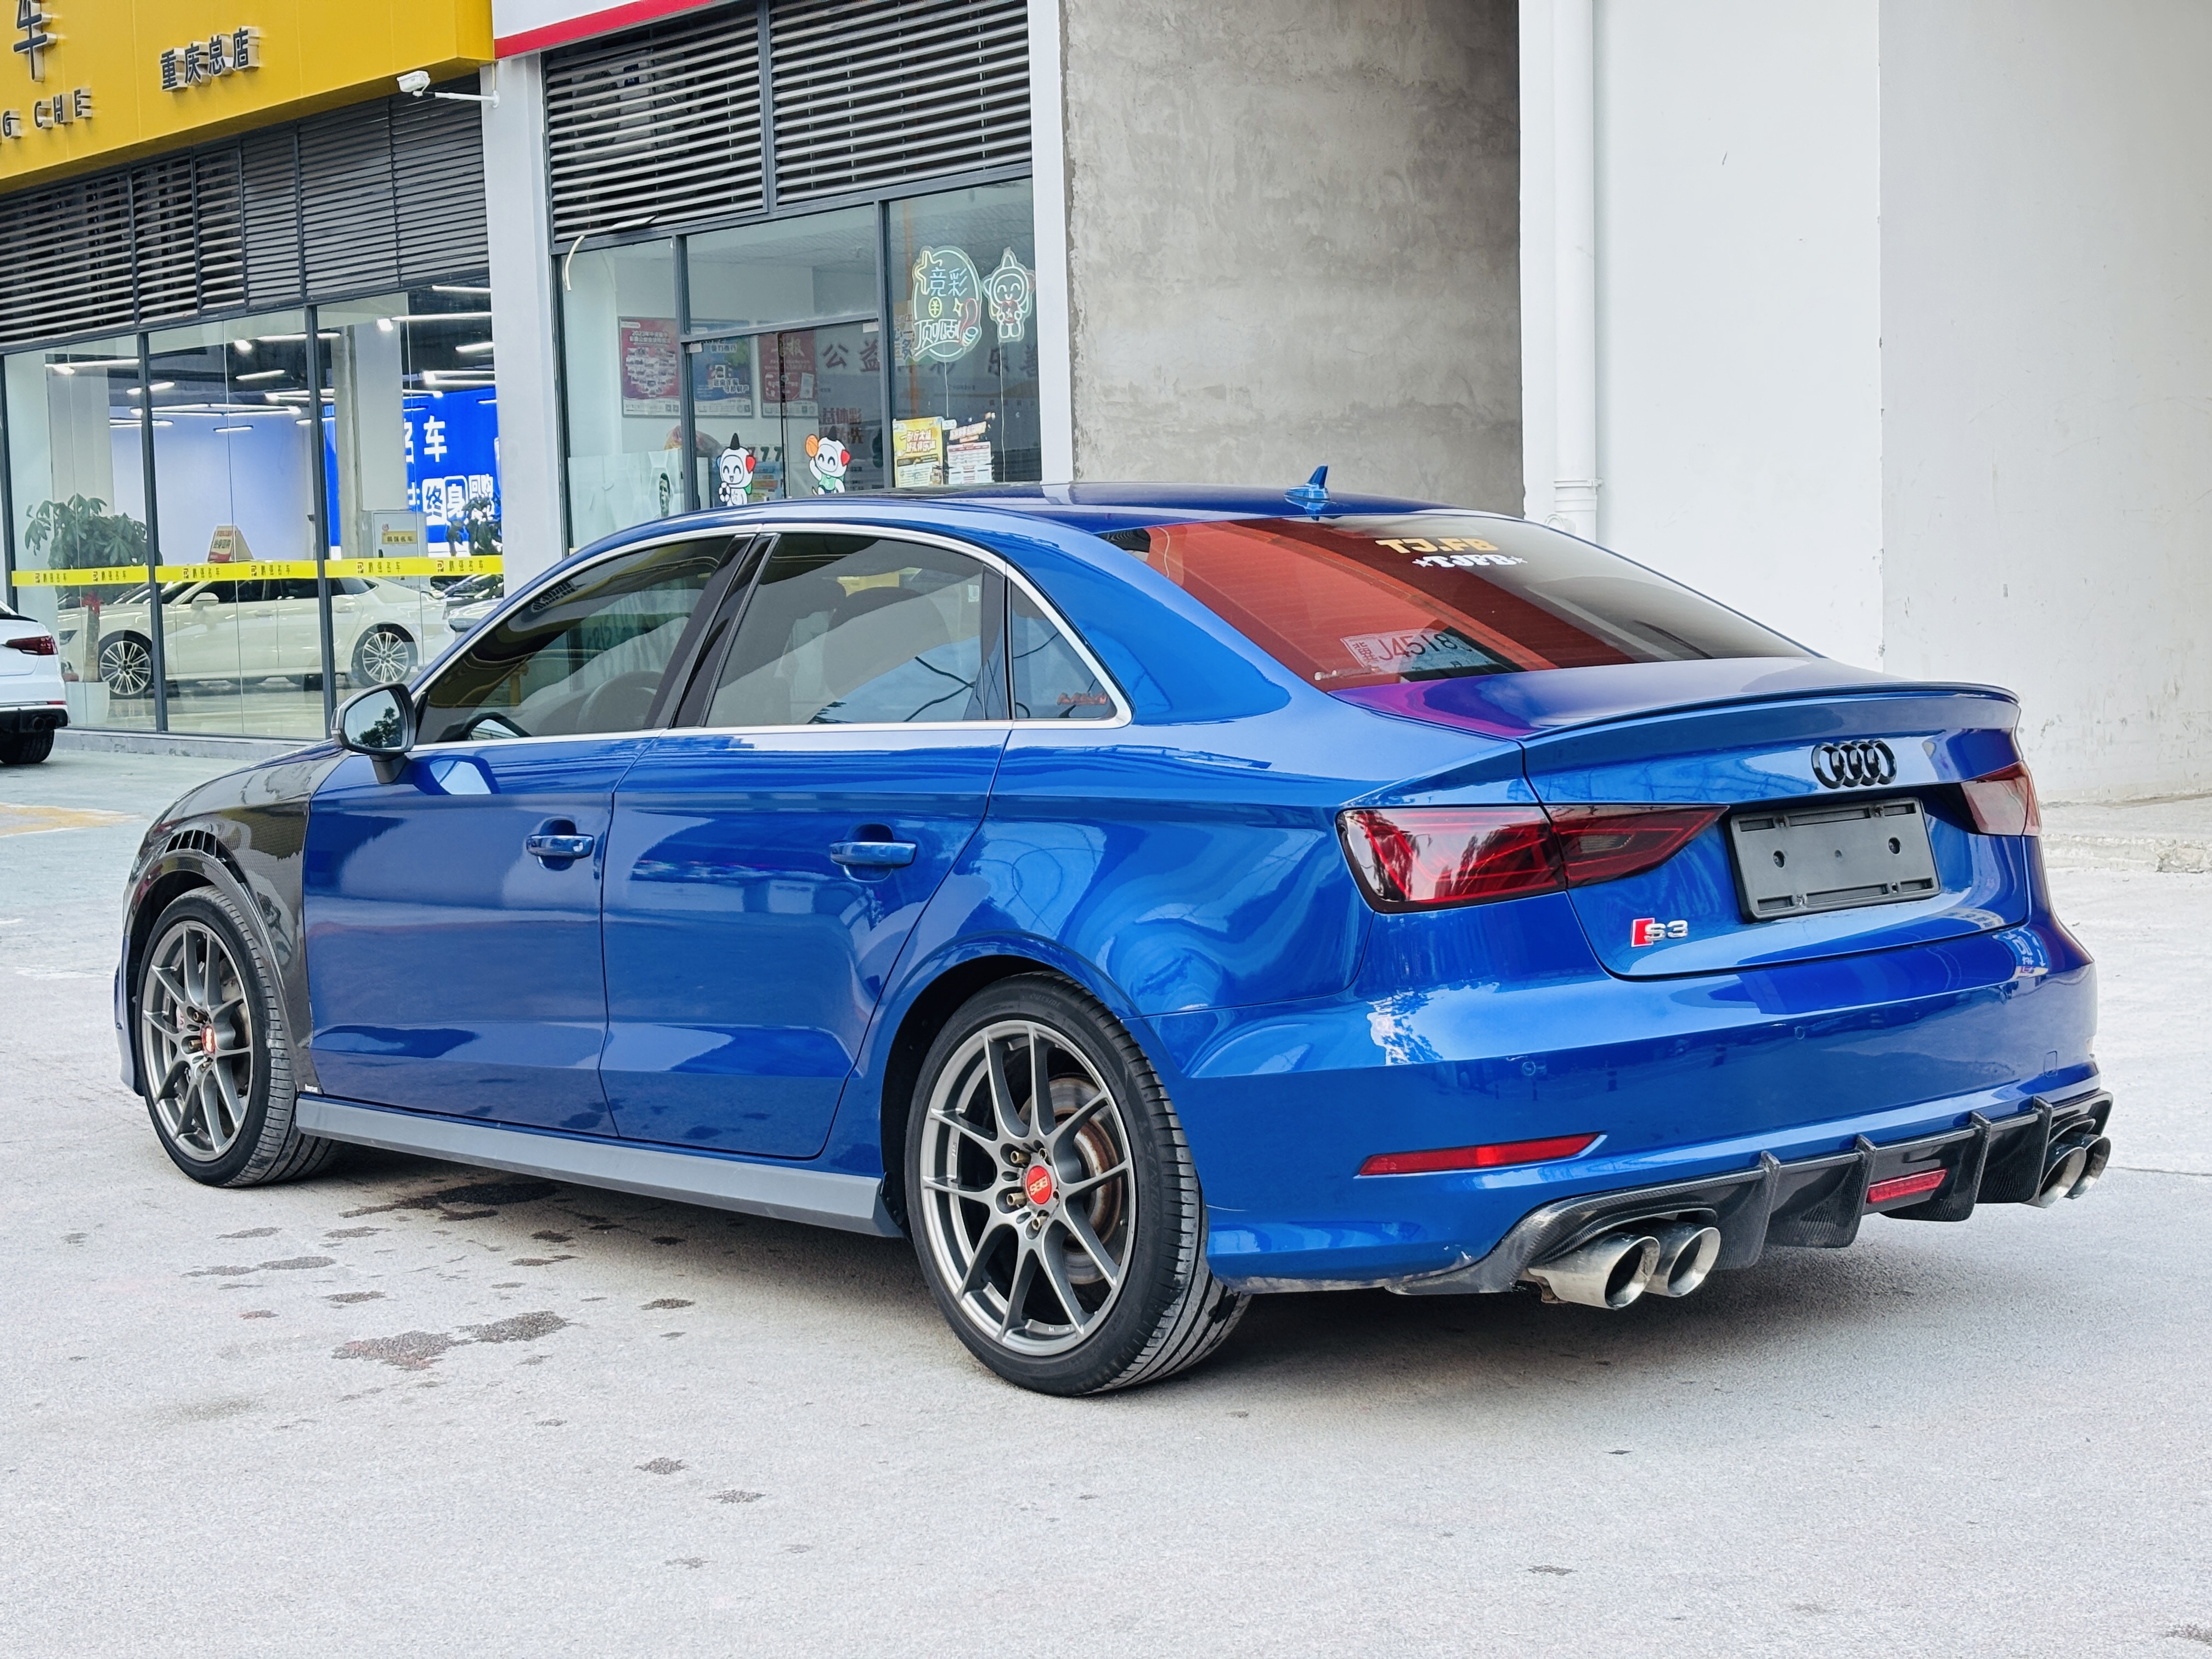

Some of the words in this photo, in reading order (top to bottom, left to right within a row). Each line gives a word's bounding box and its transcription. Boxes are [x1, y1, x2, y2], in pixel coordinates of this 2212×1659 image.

[160, 26, 258, 91] 重庆总店
[34, 88, 92, 129] CHE
[1375, 538, 1499, 554] TJ.FB
[1644, 920, 1688, 943] S3
